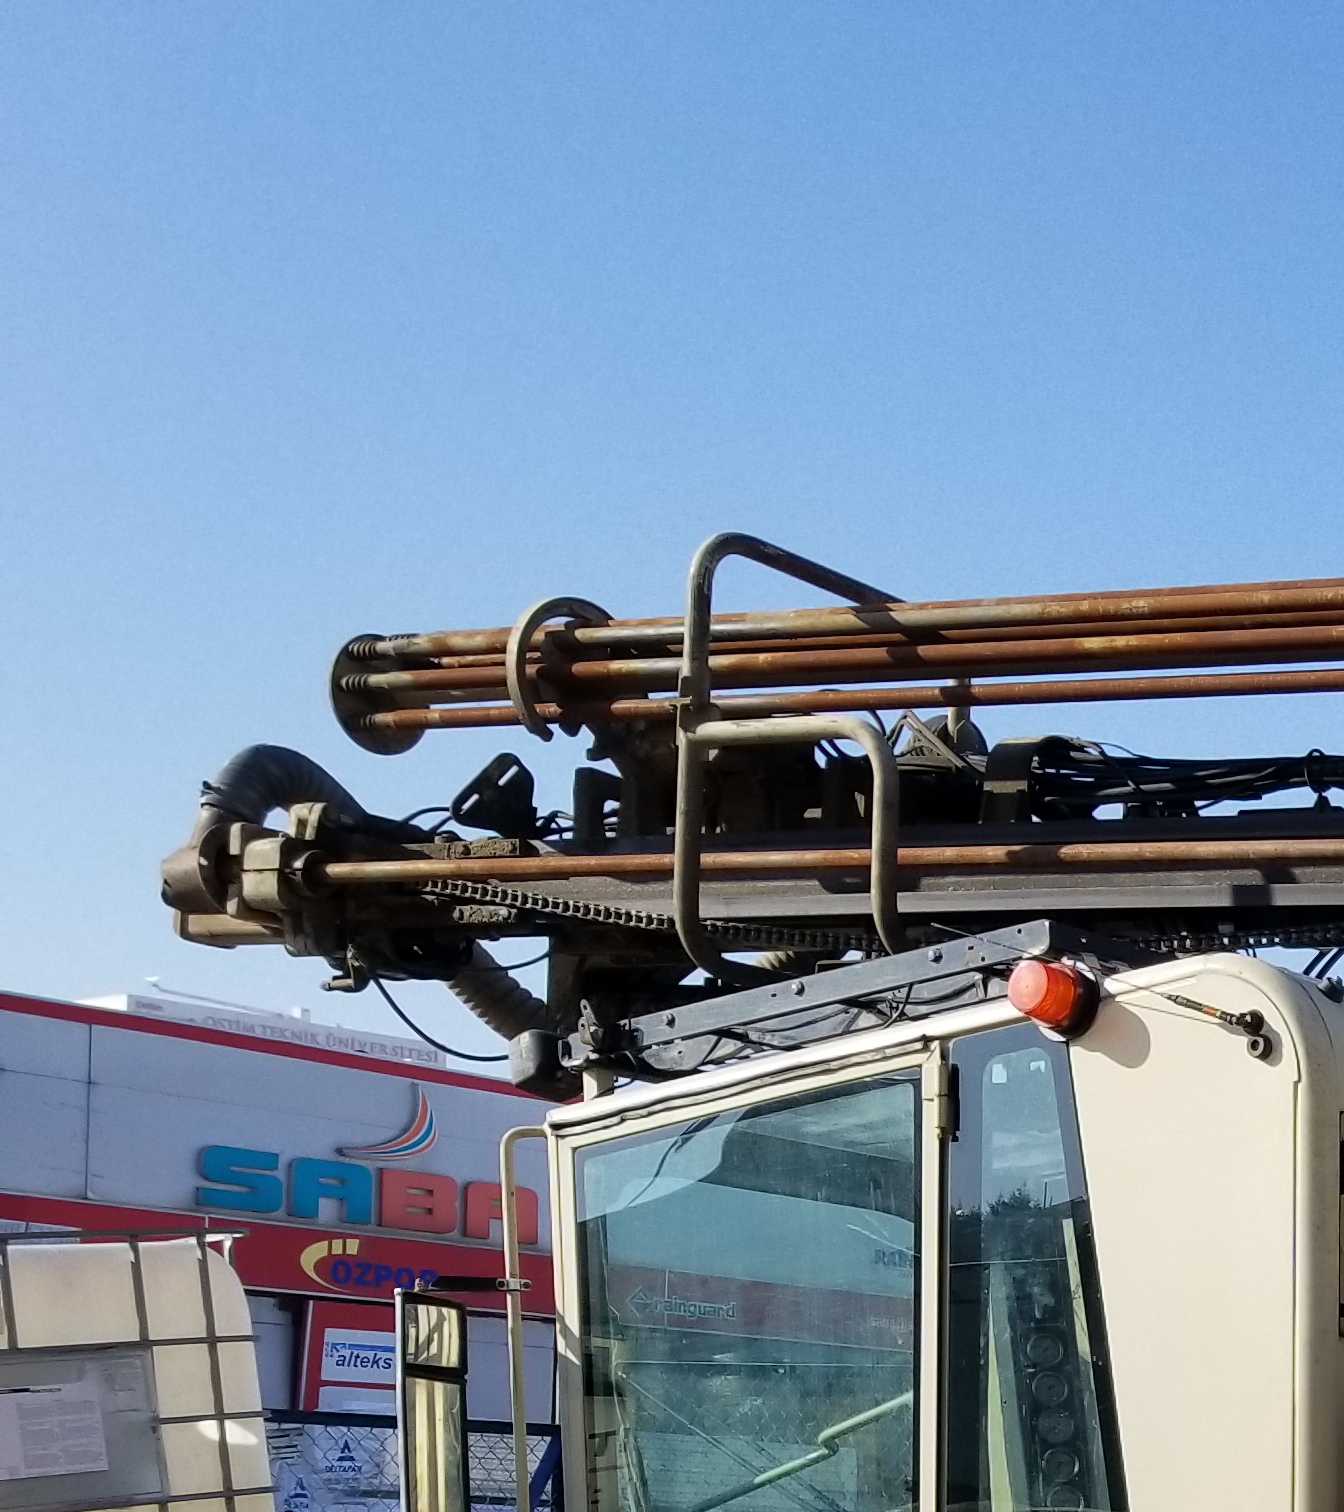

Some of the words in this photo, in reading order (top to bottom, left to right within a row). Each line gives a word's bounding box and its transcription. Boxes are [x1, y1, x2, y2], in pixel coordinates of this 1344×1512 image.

[196, 1145, 539, 1245] SABA
[653, 1296, 737, 1320] rainguard
[335, 1351, 393, 1370] alteks
